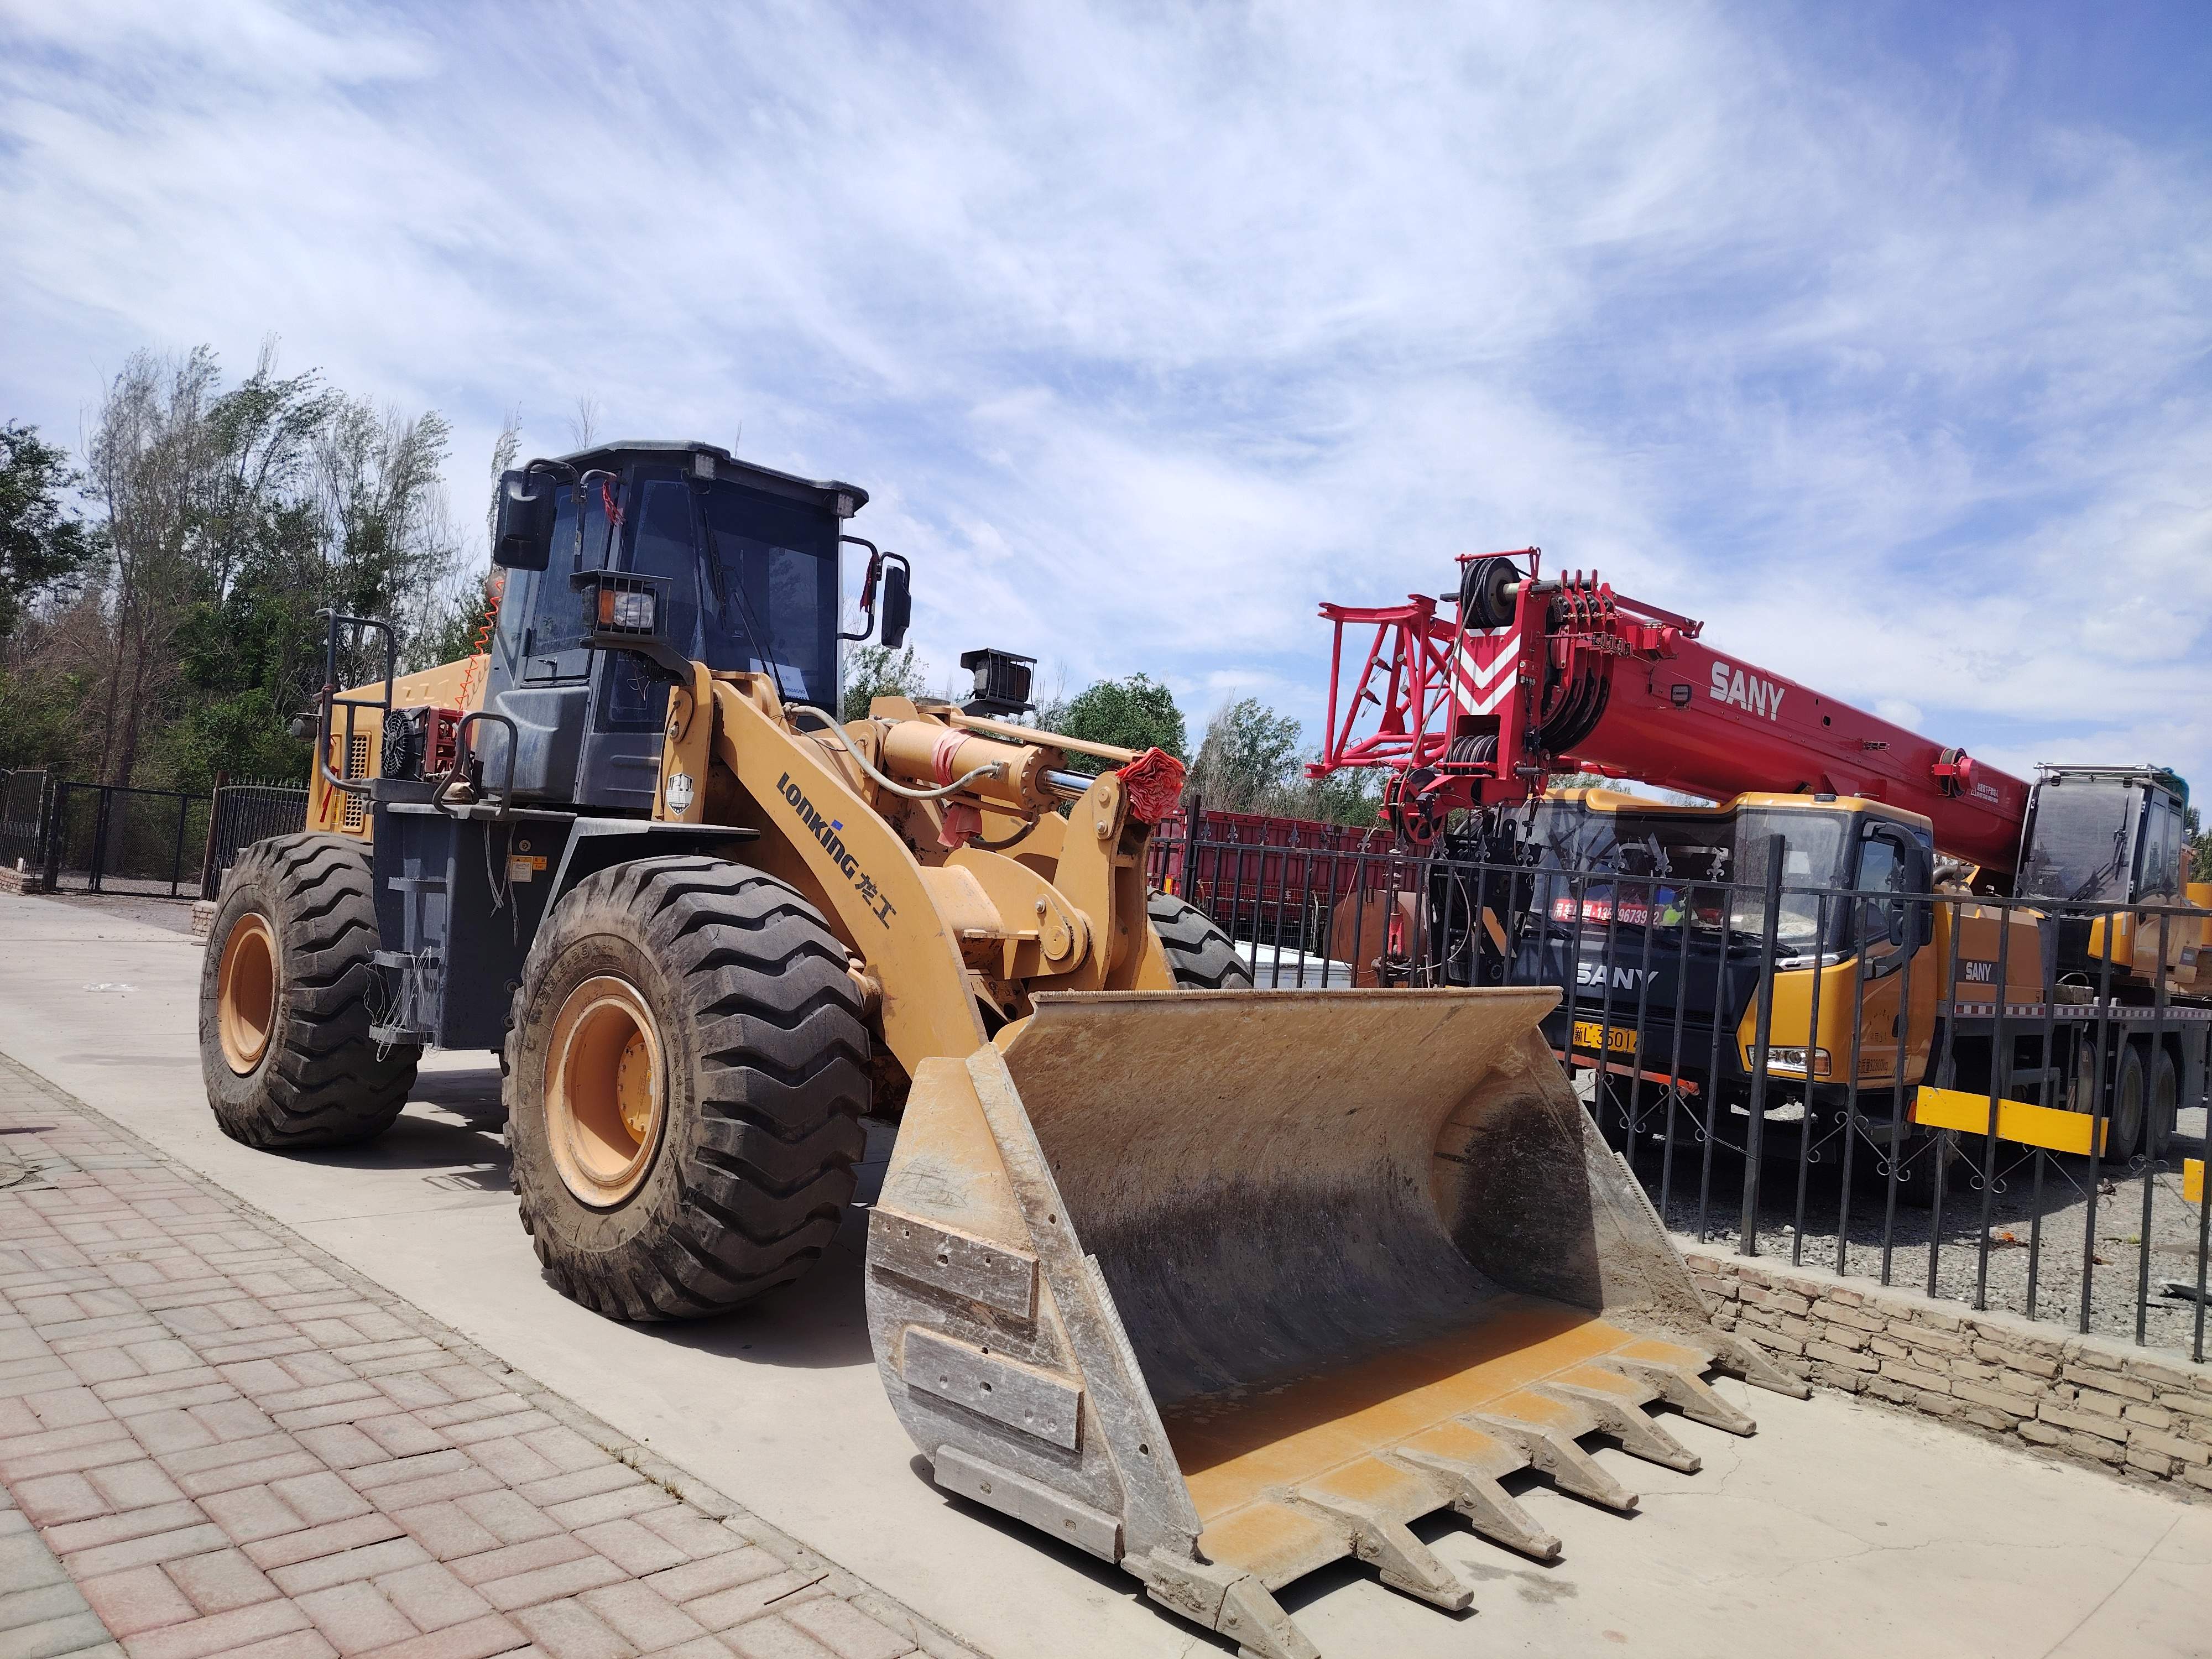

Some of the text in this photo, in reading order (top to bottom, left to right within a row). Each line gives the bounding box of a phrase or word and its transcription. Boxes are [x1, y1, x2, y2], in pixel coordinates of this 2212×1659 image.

[1710, 661, 1785, 721] SANY
[776, 772, 896, 930] LONKING 龙工
[1576, 962, 1659, 992] SANY
[1965, 962, 1992, 982] SANY
